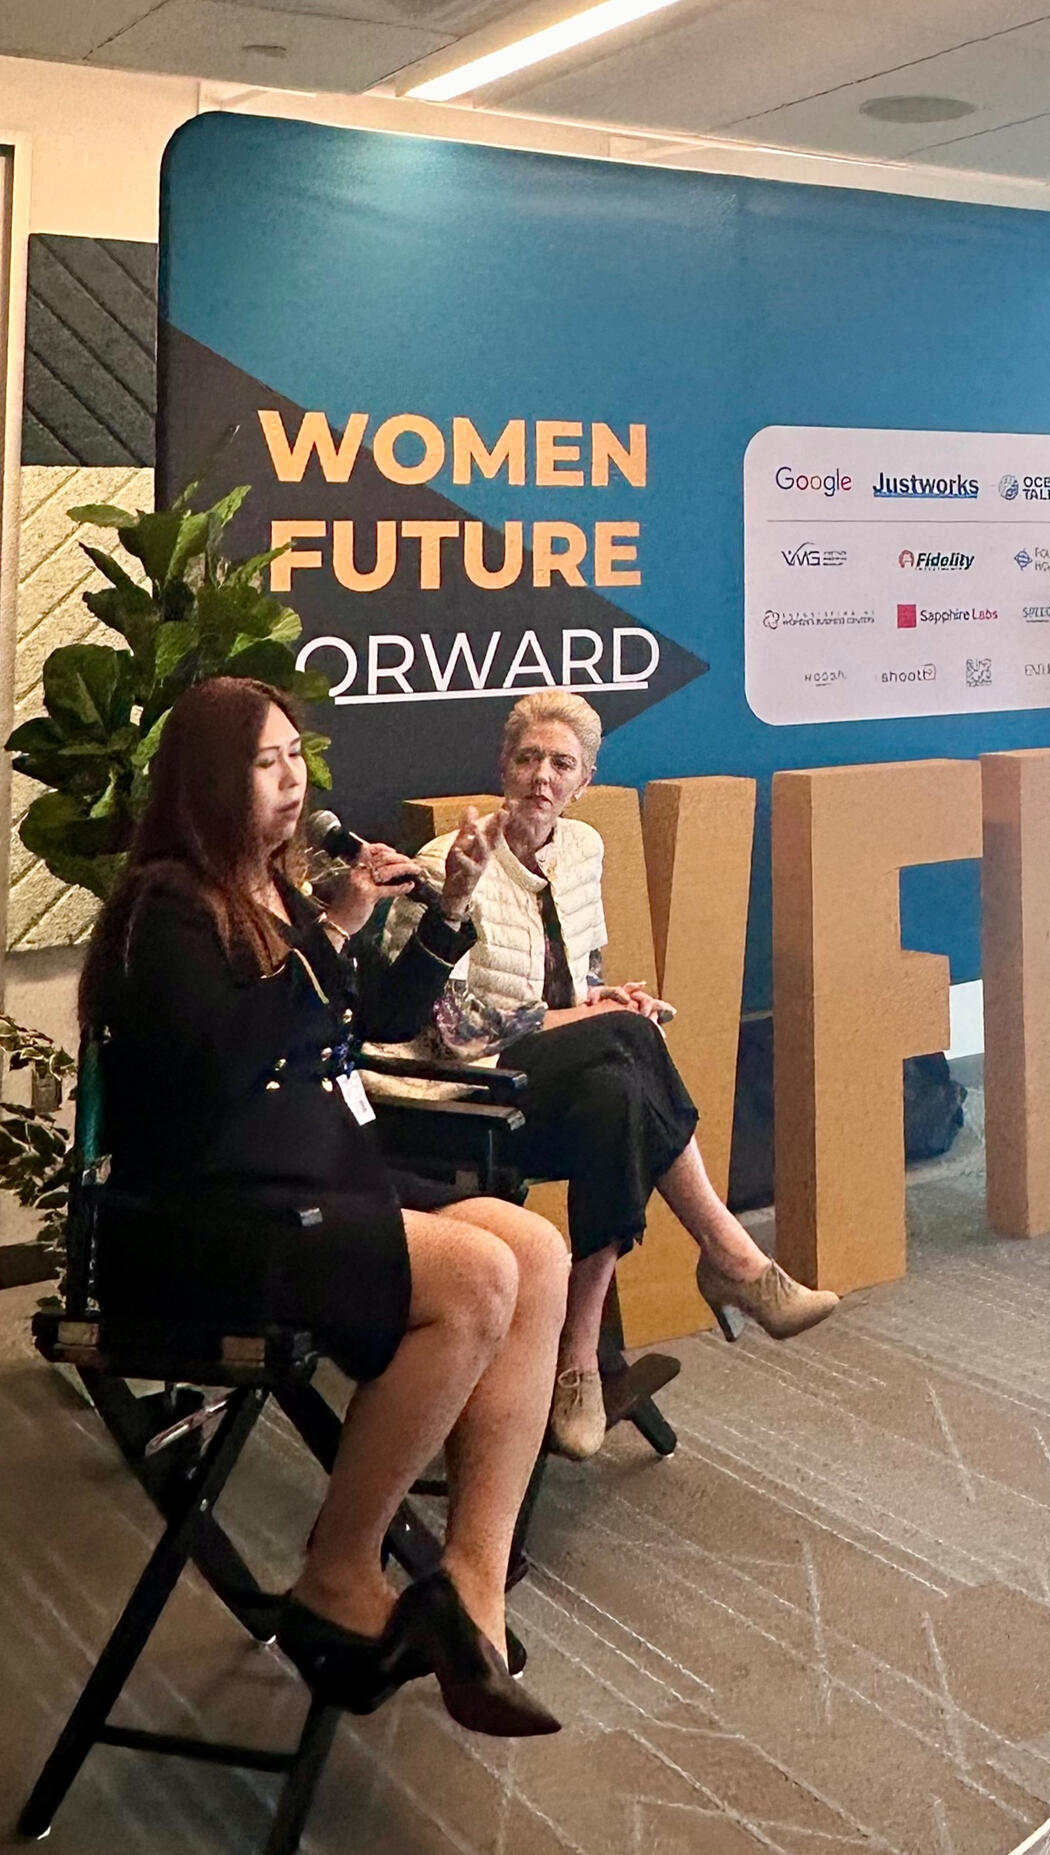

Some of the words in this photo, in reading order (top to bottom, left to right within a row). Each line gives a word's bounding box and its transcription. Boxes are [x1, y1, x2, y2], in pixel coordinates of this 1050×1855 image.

[258, 410, 647, 488] WOMEN
[775, 466, 852, 496] Google
[873, 472, 980, 496] Justworks
[270, 520, 642, 592] FUTURE
[920, 608, 970, 625] Sapphire
[972, 608, 998, 621] Labs
[294, 626, 661, 698] ORWARD
